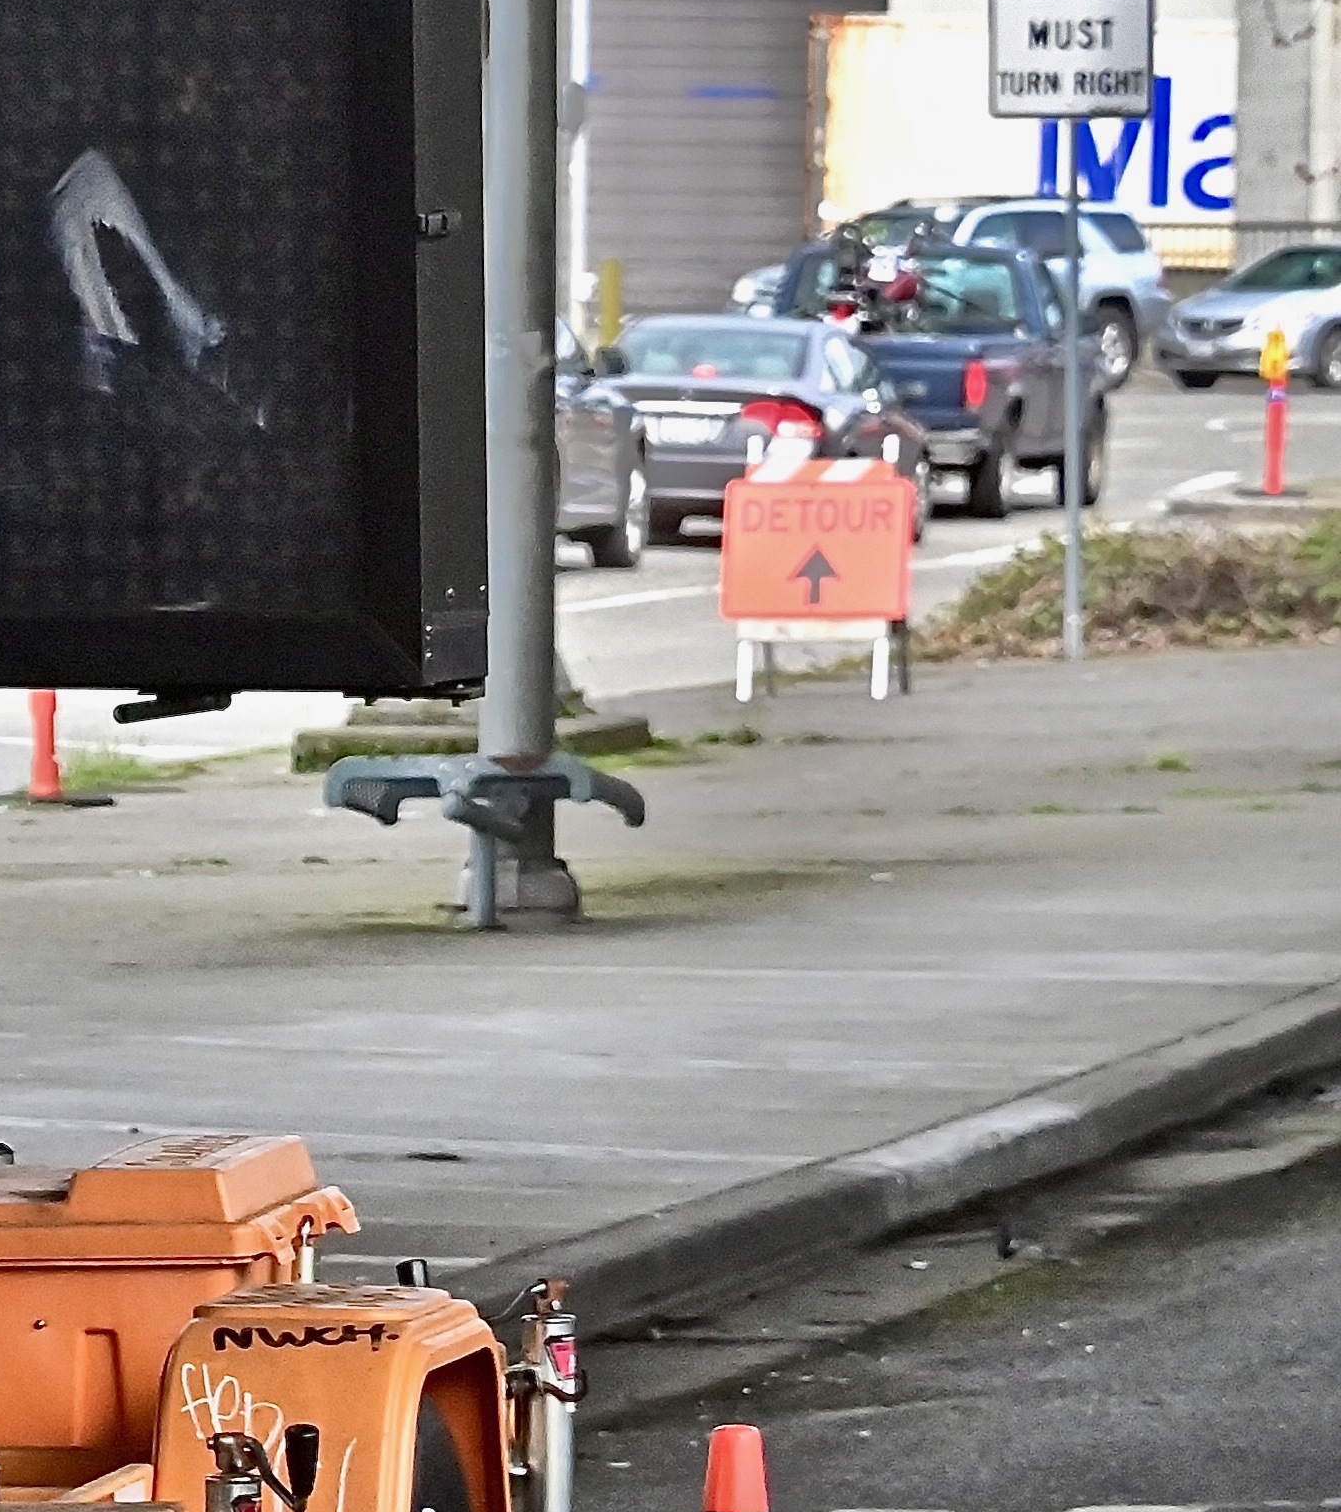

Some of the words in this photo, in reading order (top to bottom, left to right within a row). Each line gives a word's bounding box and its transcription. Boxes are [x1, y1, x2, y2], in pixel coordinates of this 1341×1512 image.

[1027, 18, 1114, 50] MUST
[997, 72, 1060, 96] TURN
[1073, 71, 1143, 96] RIGHT
[742, 497, 894, 533] DETOUR
